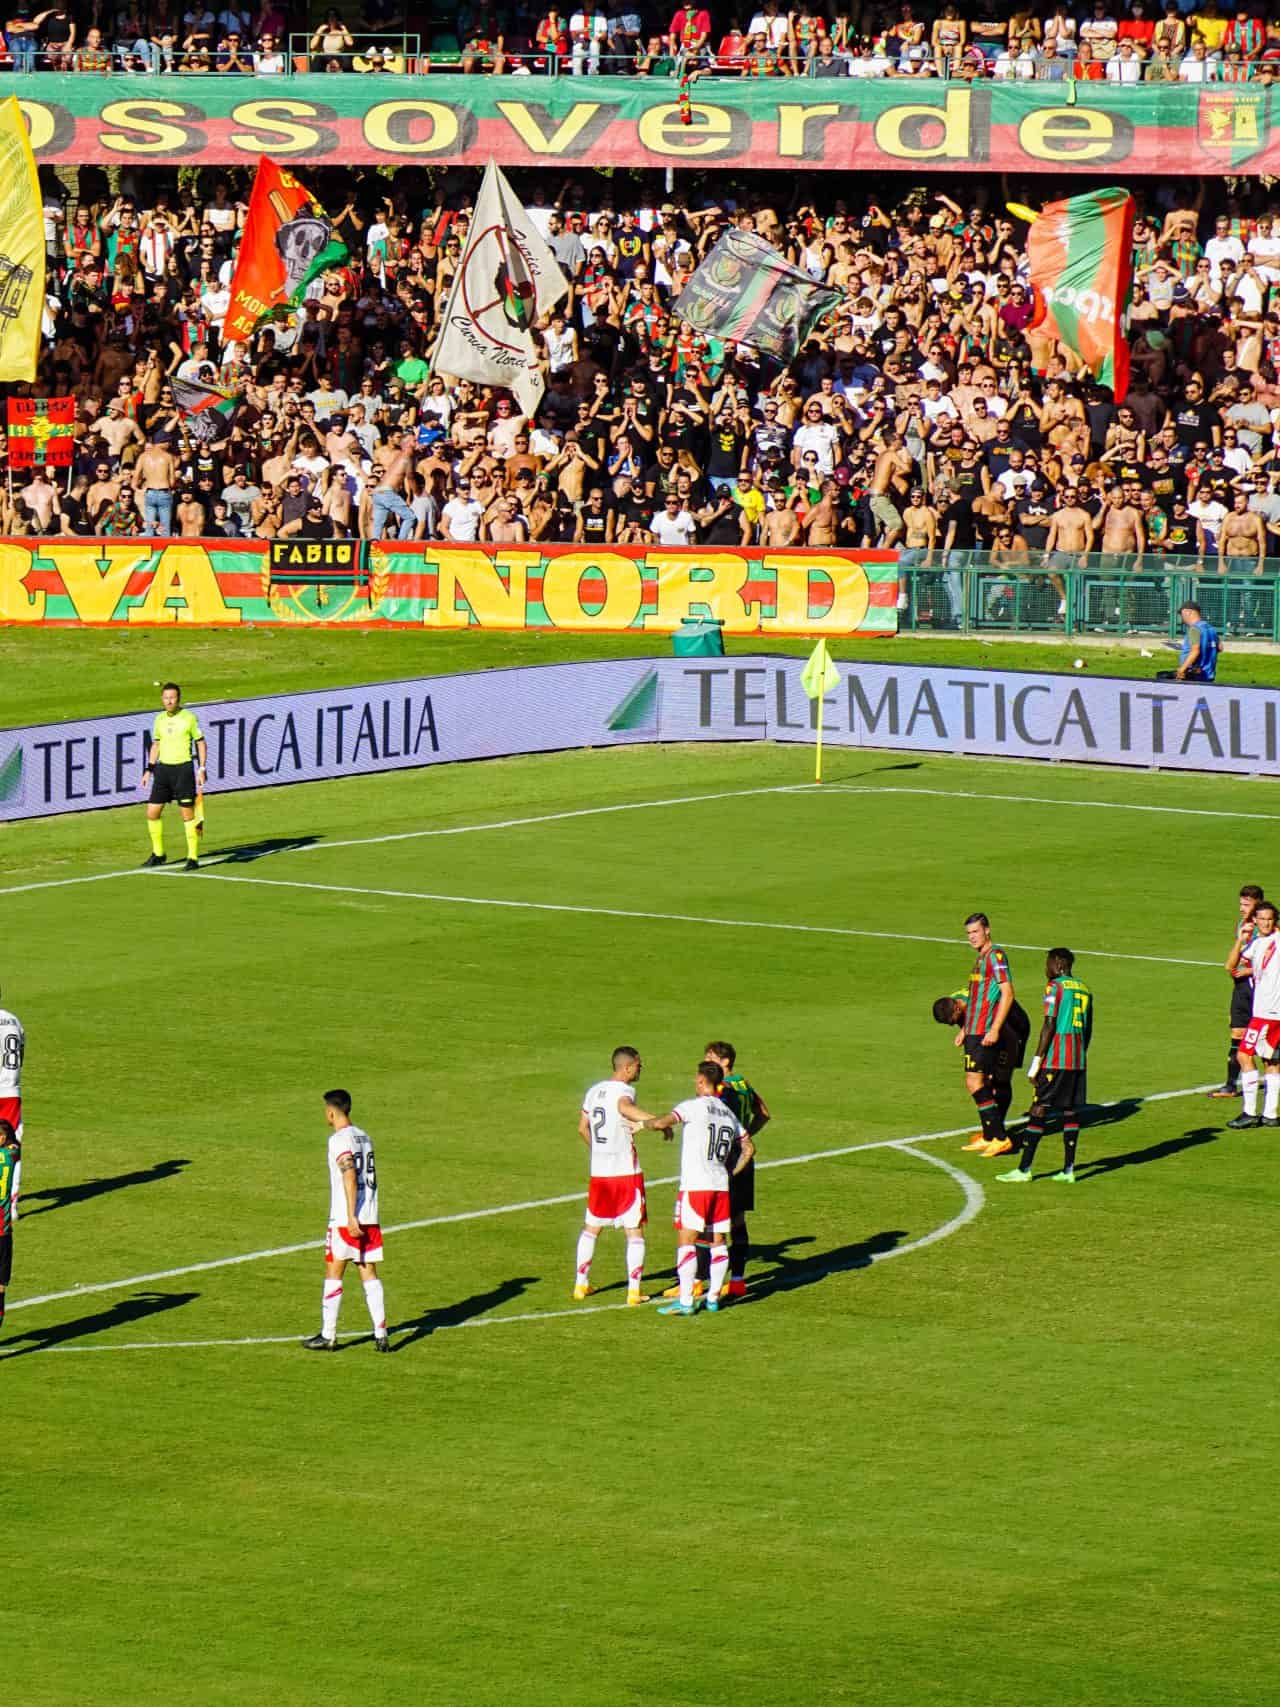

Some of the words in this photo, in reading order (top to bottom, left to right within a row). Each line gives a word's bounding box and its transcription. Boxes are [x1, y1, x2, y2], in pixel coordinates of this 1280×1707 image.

[274, 544, 352, 563] FABIO
[423, 547, 870, 633] NORD
[34, 711, 302, 803] TELETICA
[315, 695, 440, 767] ITALIA
[593, 1106, 607, 1144] 2
[708, 1123, 735, 1161] 16
